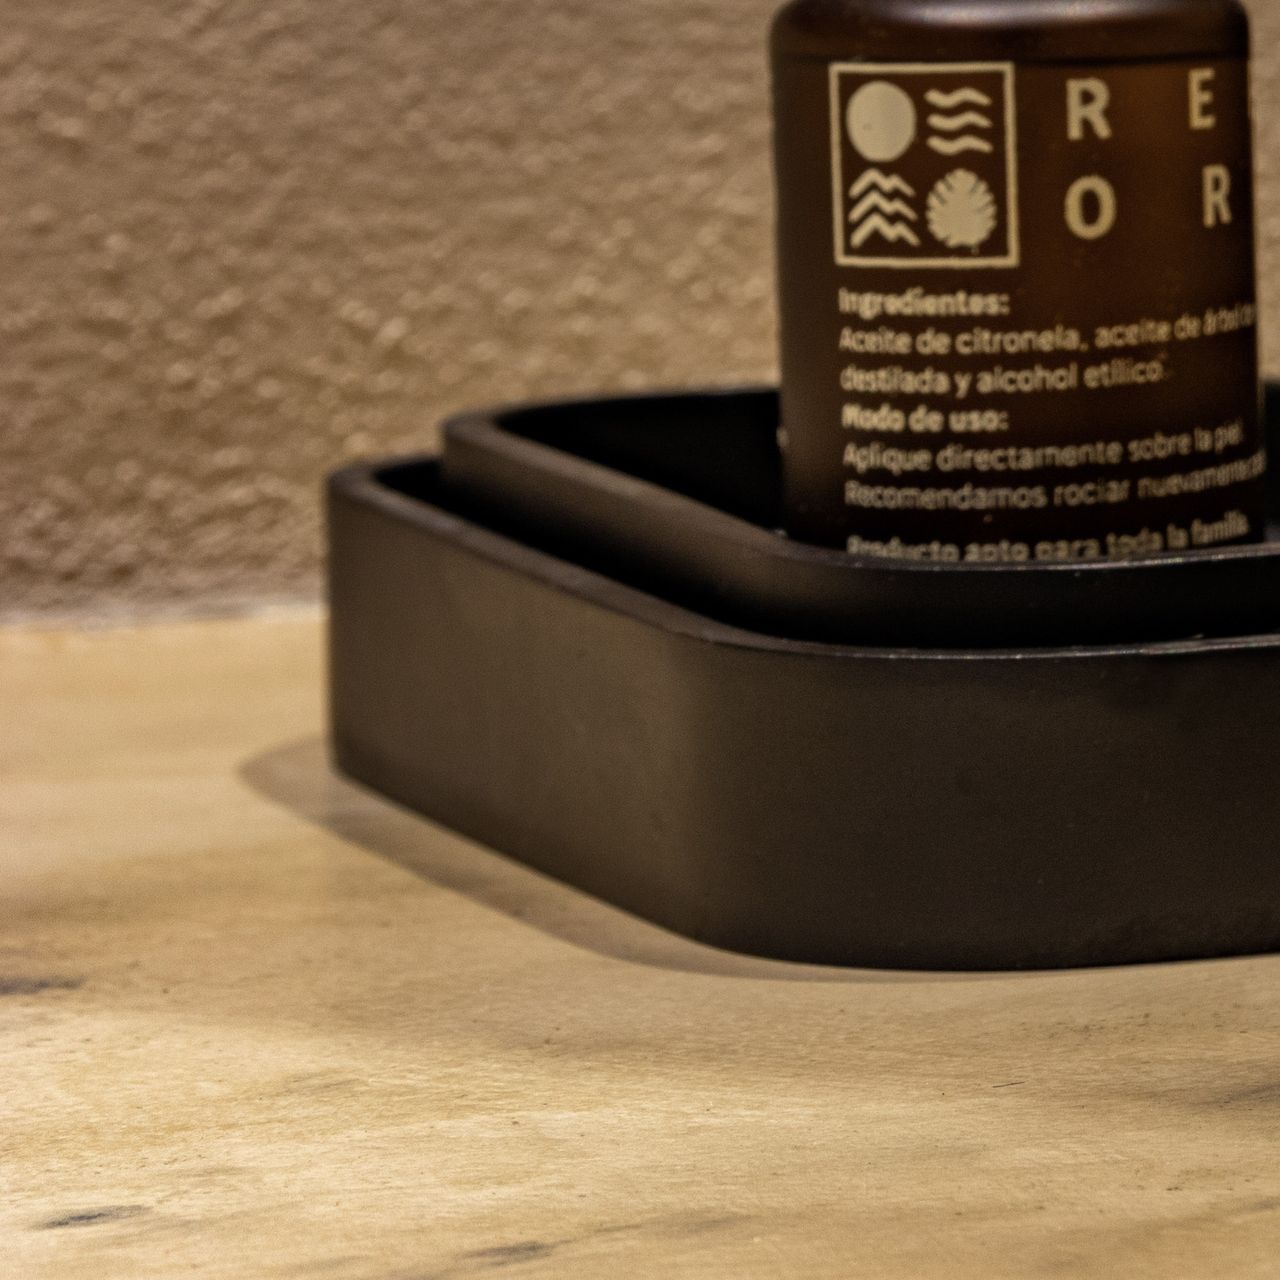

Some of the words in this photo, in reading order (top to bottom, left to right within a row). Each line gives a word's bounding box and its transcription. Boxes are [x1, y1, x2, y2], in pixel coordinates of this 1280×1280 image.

[838, 286, 1011, 320] Ingredientes:
[838, 326, 913, 354] Aceite
[915, 326, 950, 355] de
[1095, 319, 1172, 349] aceite
[1174, 312, 1201, 340] de
[839, 365, 950, 394] destilada
[954, 373, 972, 400] y
[977, 364, 1078, 395] alcohol
[842, 403, 906, 432] Modo
[909, 404, 945, 433] de
[949, 410, 1009, 433] uso:
[843, 442, 933, 476] Aplique
[936, 443, 1123, 472] directamente
[1128, 431, 1193, 462] sobre
[845, 480, 1048, 510] Recomendamos
[1053, 479, 1131, 507] rociar
